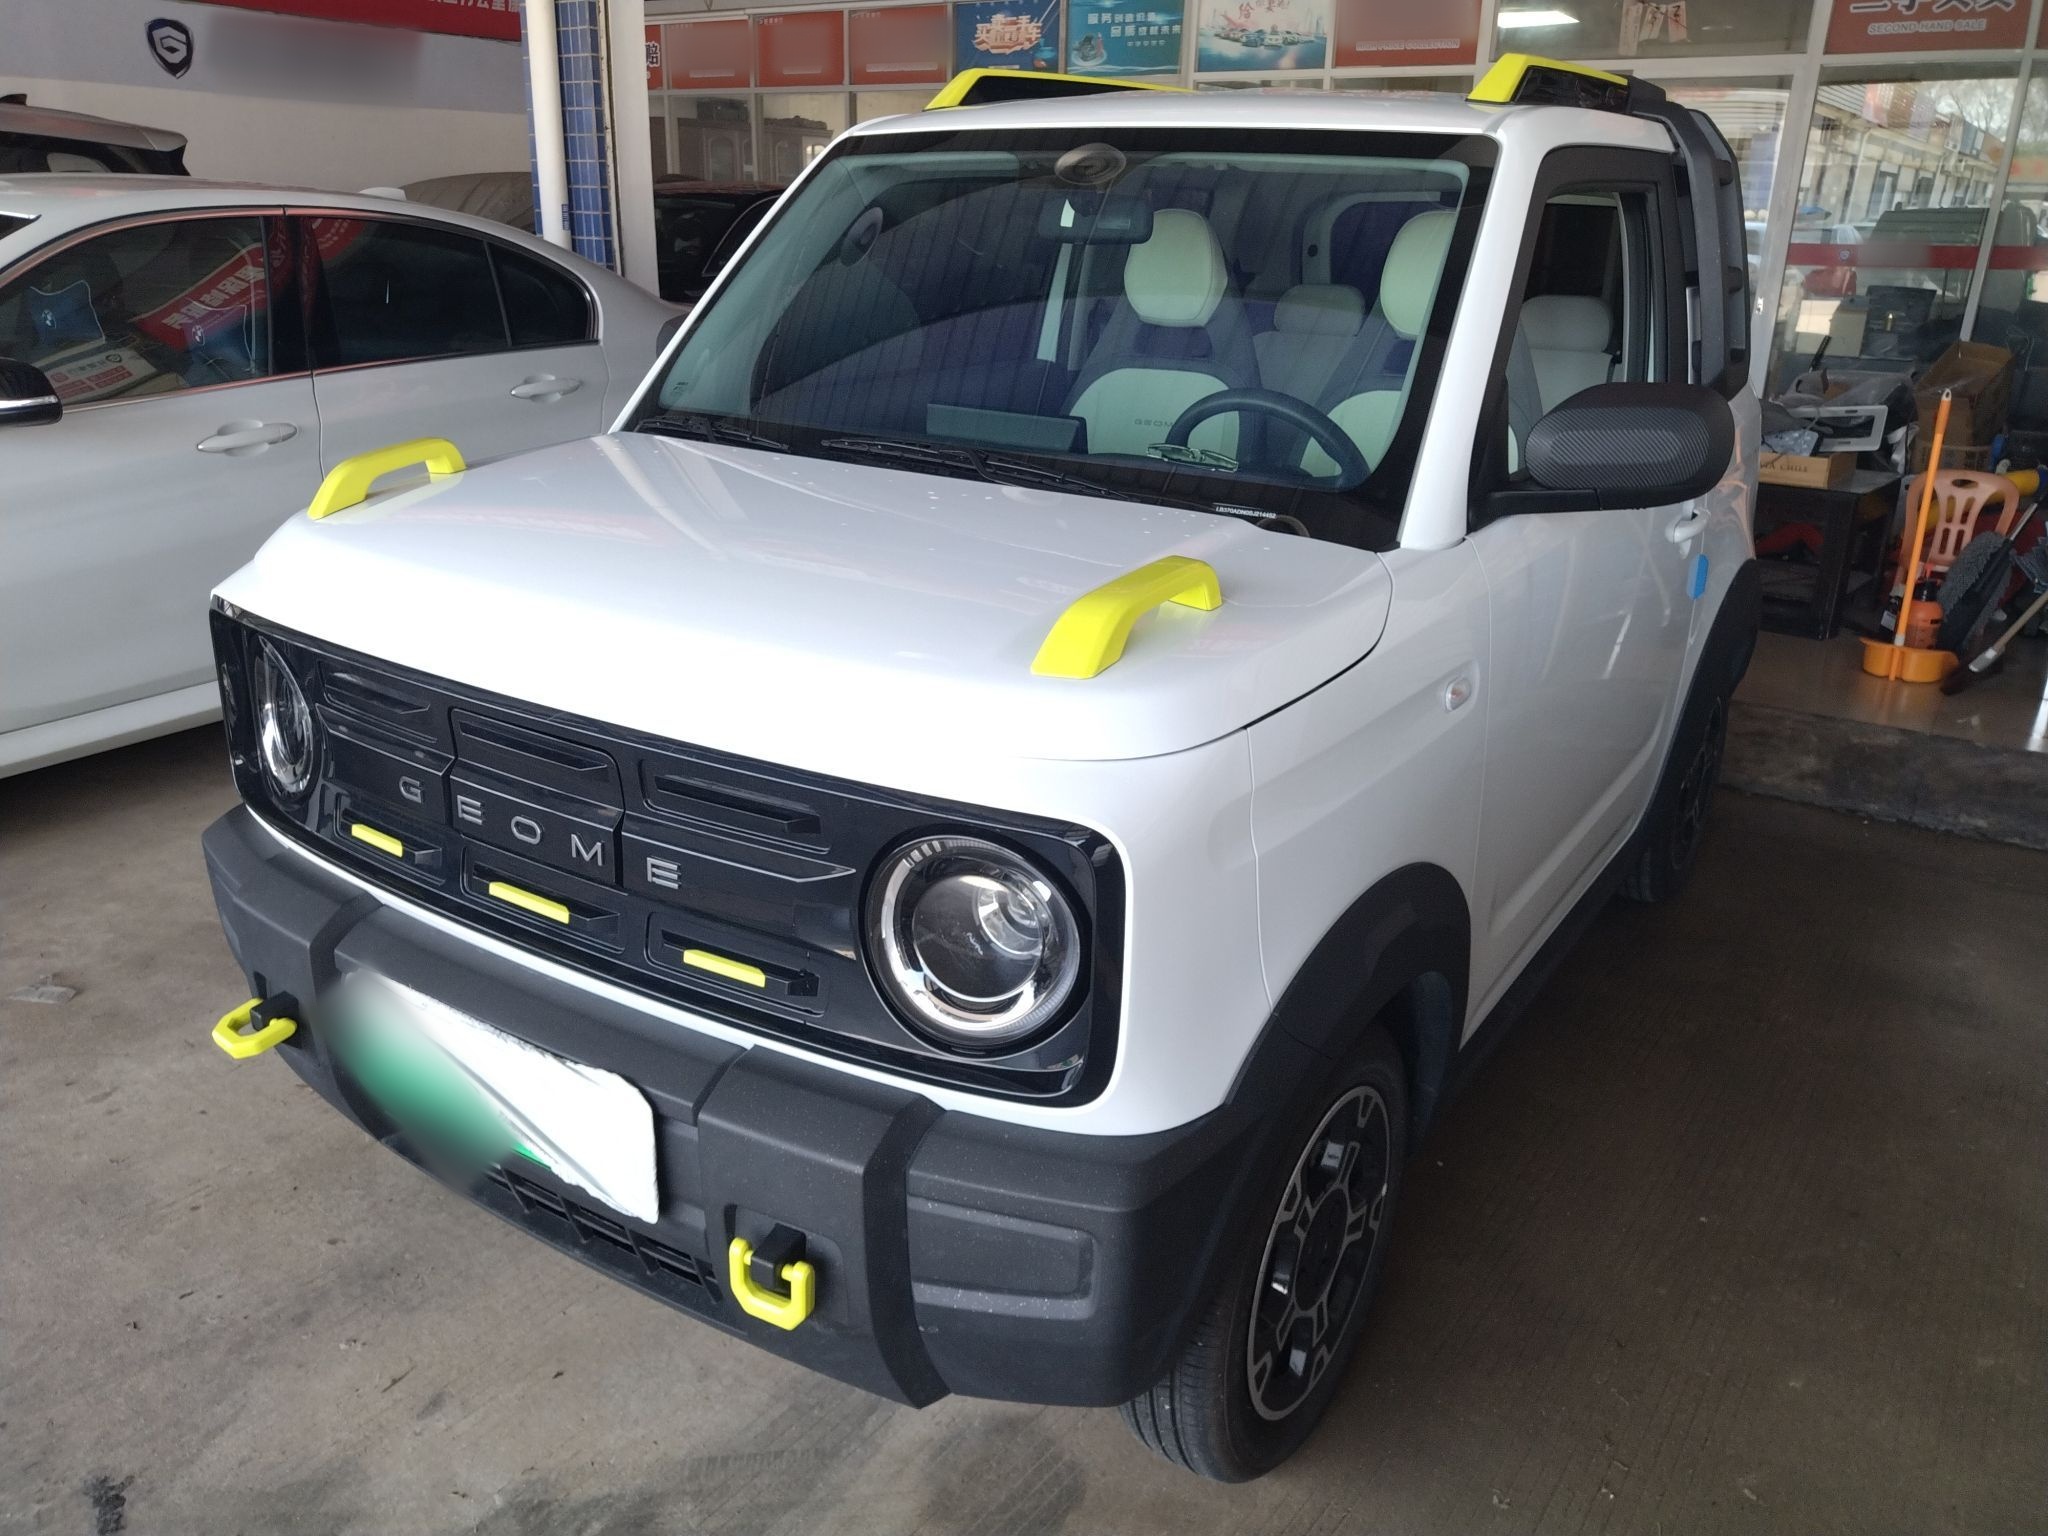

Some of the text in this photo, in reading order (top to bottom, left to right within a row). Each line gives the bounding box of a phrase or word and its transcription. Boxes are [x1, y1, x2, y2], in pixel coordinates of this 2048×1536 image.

[1868, 19, 1986, 34] SECOND HAND SALE
[399, 775, 682, 889] GEOME
